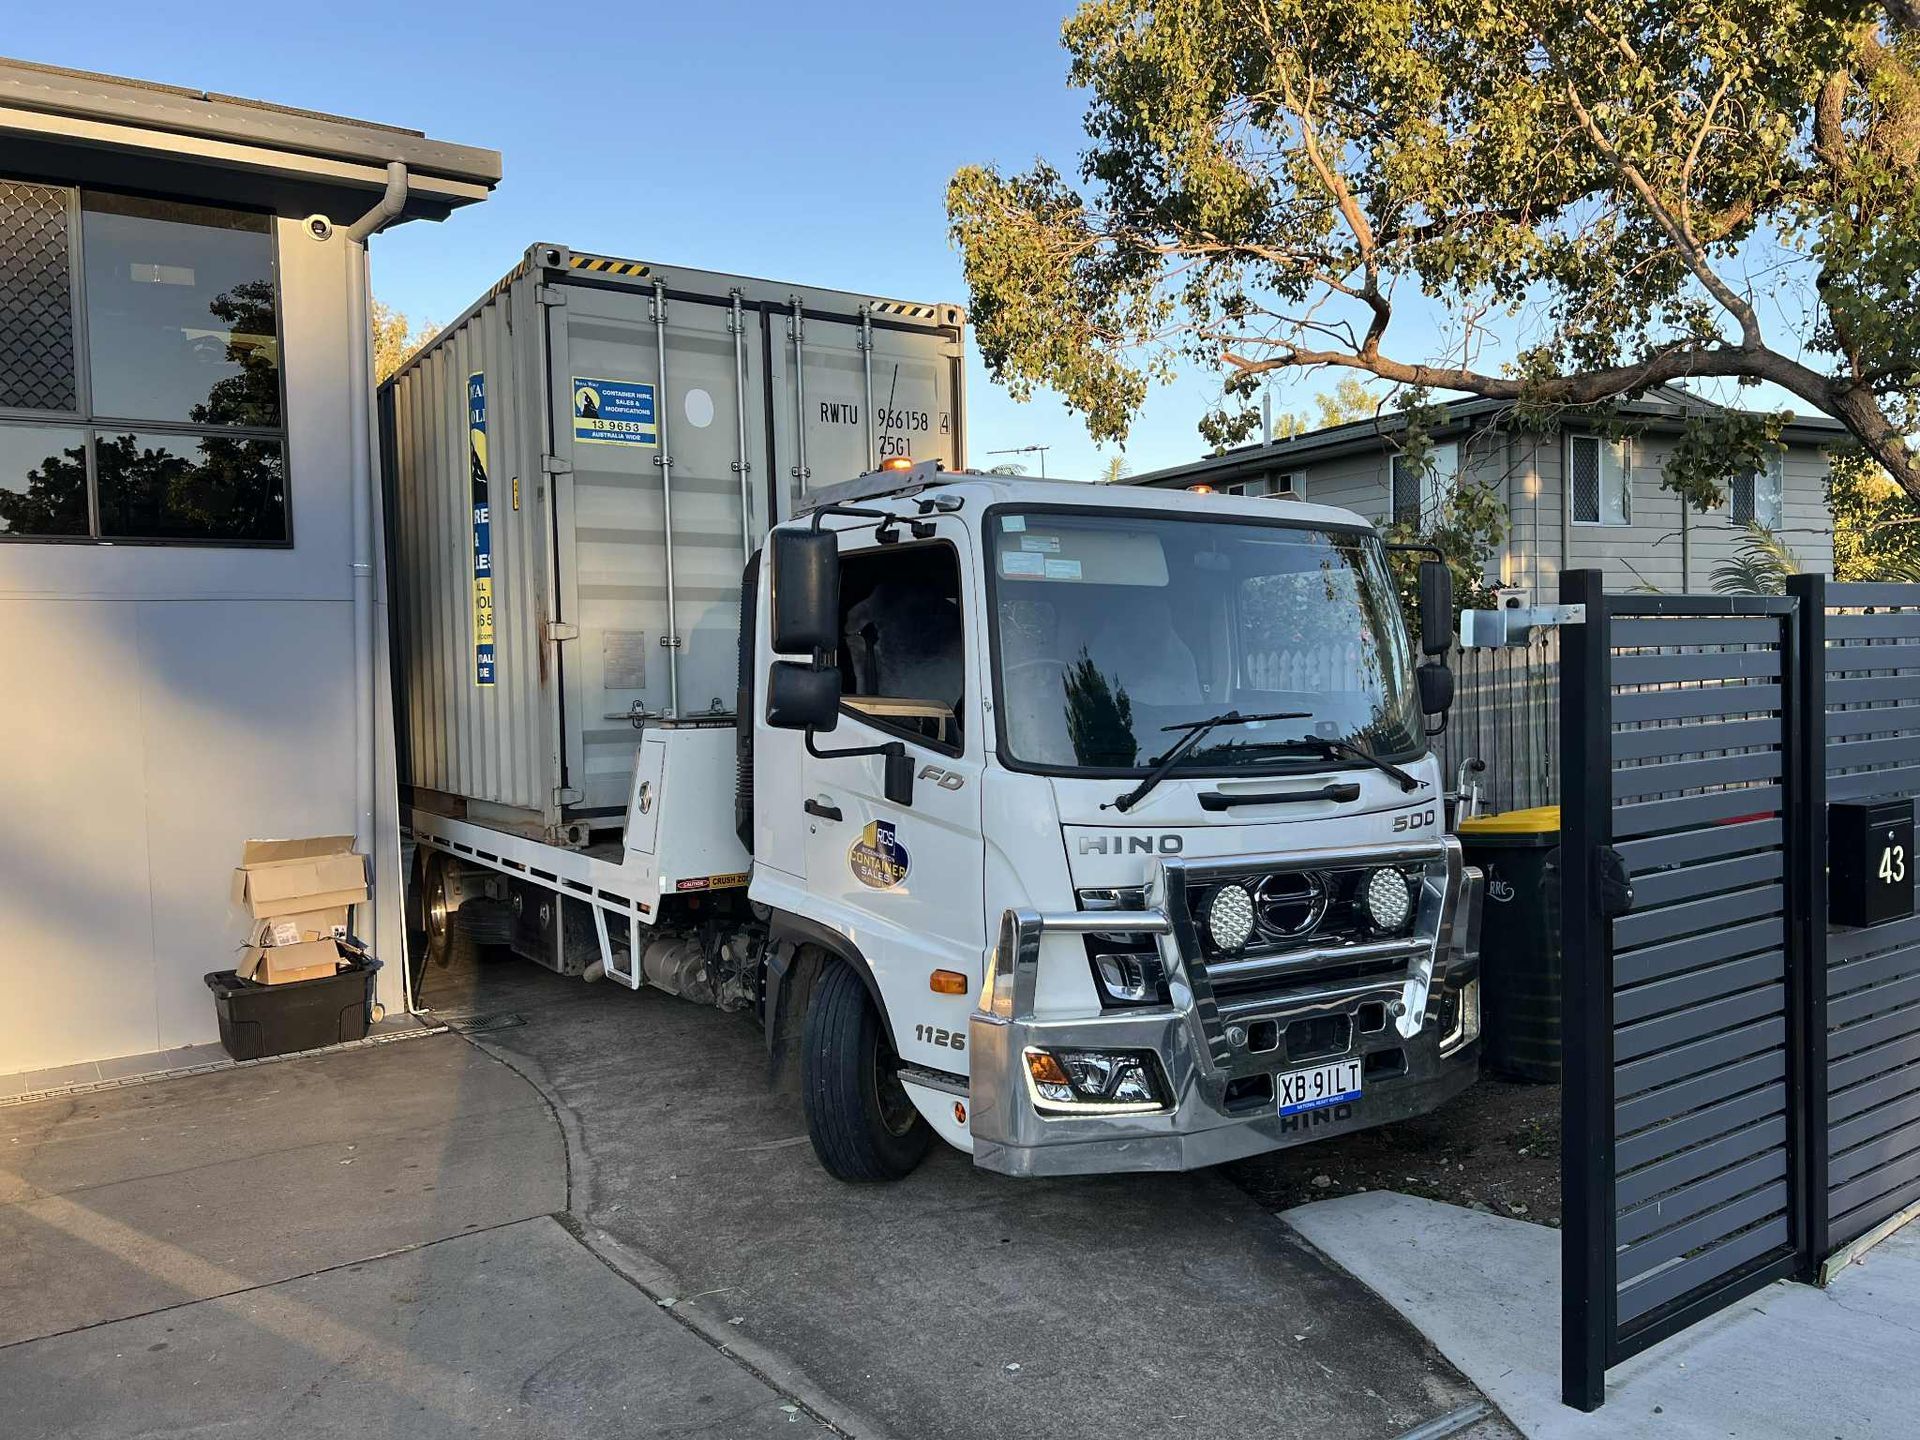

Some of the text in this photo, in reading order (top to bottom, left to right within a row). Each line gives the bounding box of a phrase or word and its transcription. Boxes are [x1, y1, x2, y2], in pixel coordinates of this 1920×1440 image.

[602, 389, 636, 399] CONTAINER
[605, 406, 651, 415] MODIFICATIONS
[820, 402, 949, 433] RWTU 966158 4
[592, 420, 640, 432] 13 9653
[592, 431, 625, 439] AUSTRALIA
[878, 435, 911, 456] 25G1
[917, 765, 964, 790] FD
[1392, 809, 1435, 832] 500
[877, 828, 895, 846] RCS
[1079, 834, 1183, 854] HINO
[851, 850, 905, 877] CONTAINER
[1879, 845, 1905, 884] 43
[712, 875, 735, 886] CRUSH
[861, 866, 890, 883] SALES
[915, 1024, 966, 1051] 1126
[1281, 1104, 1352, 1133] HINO
